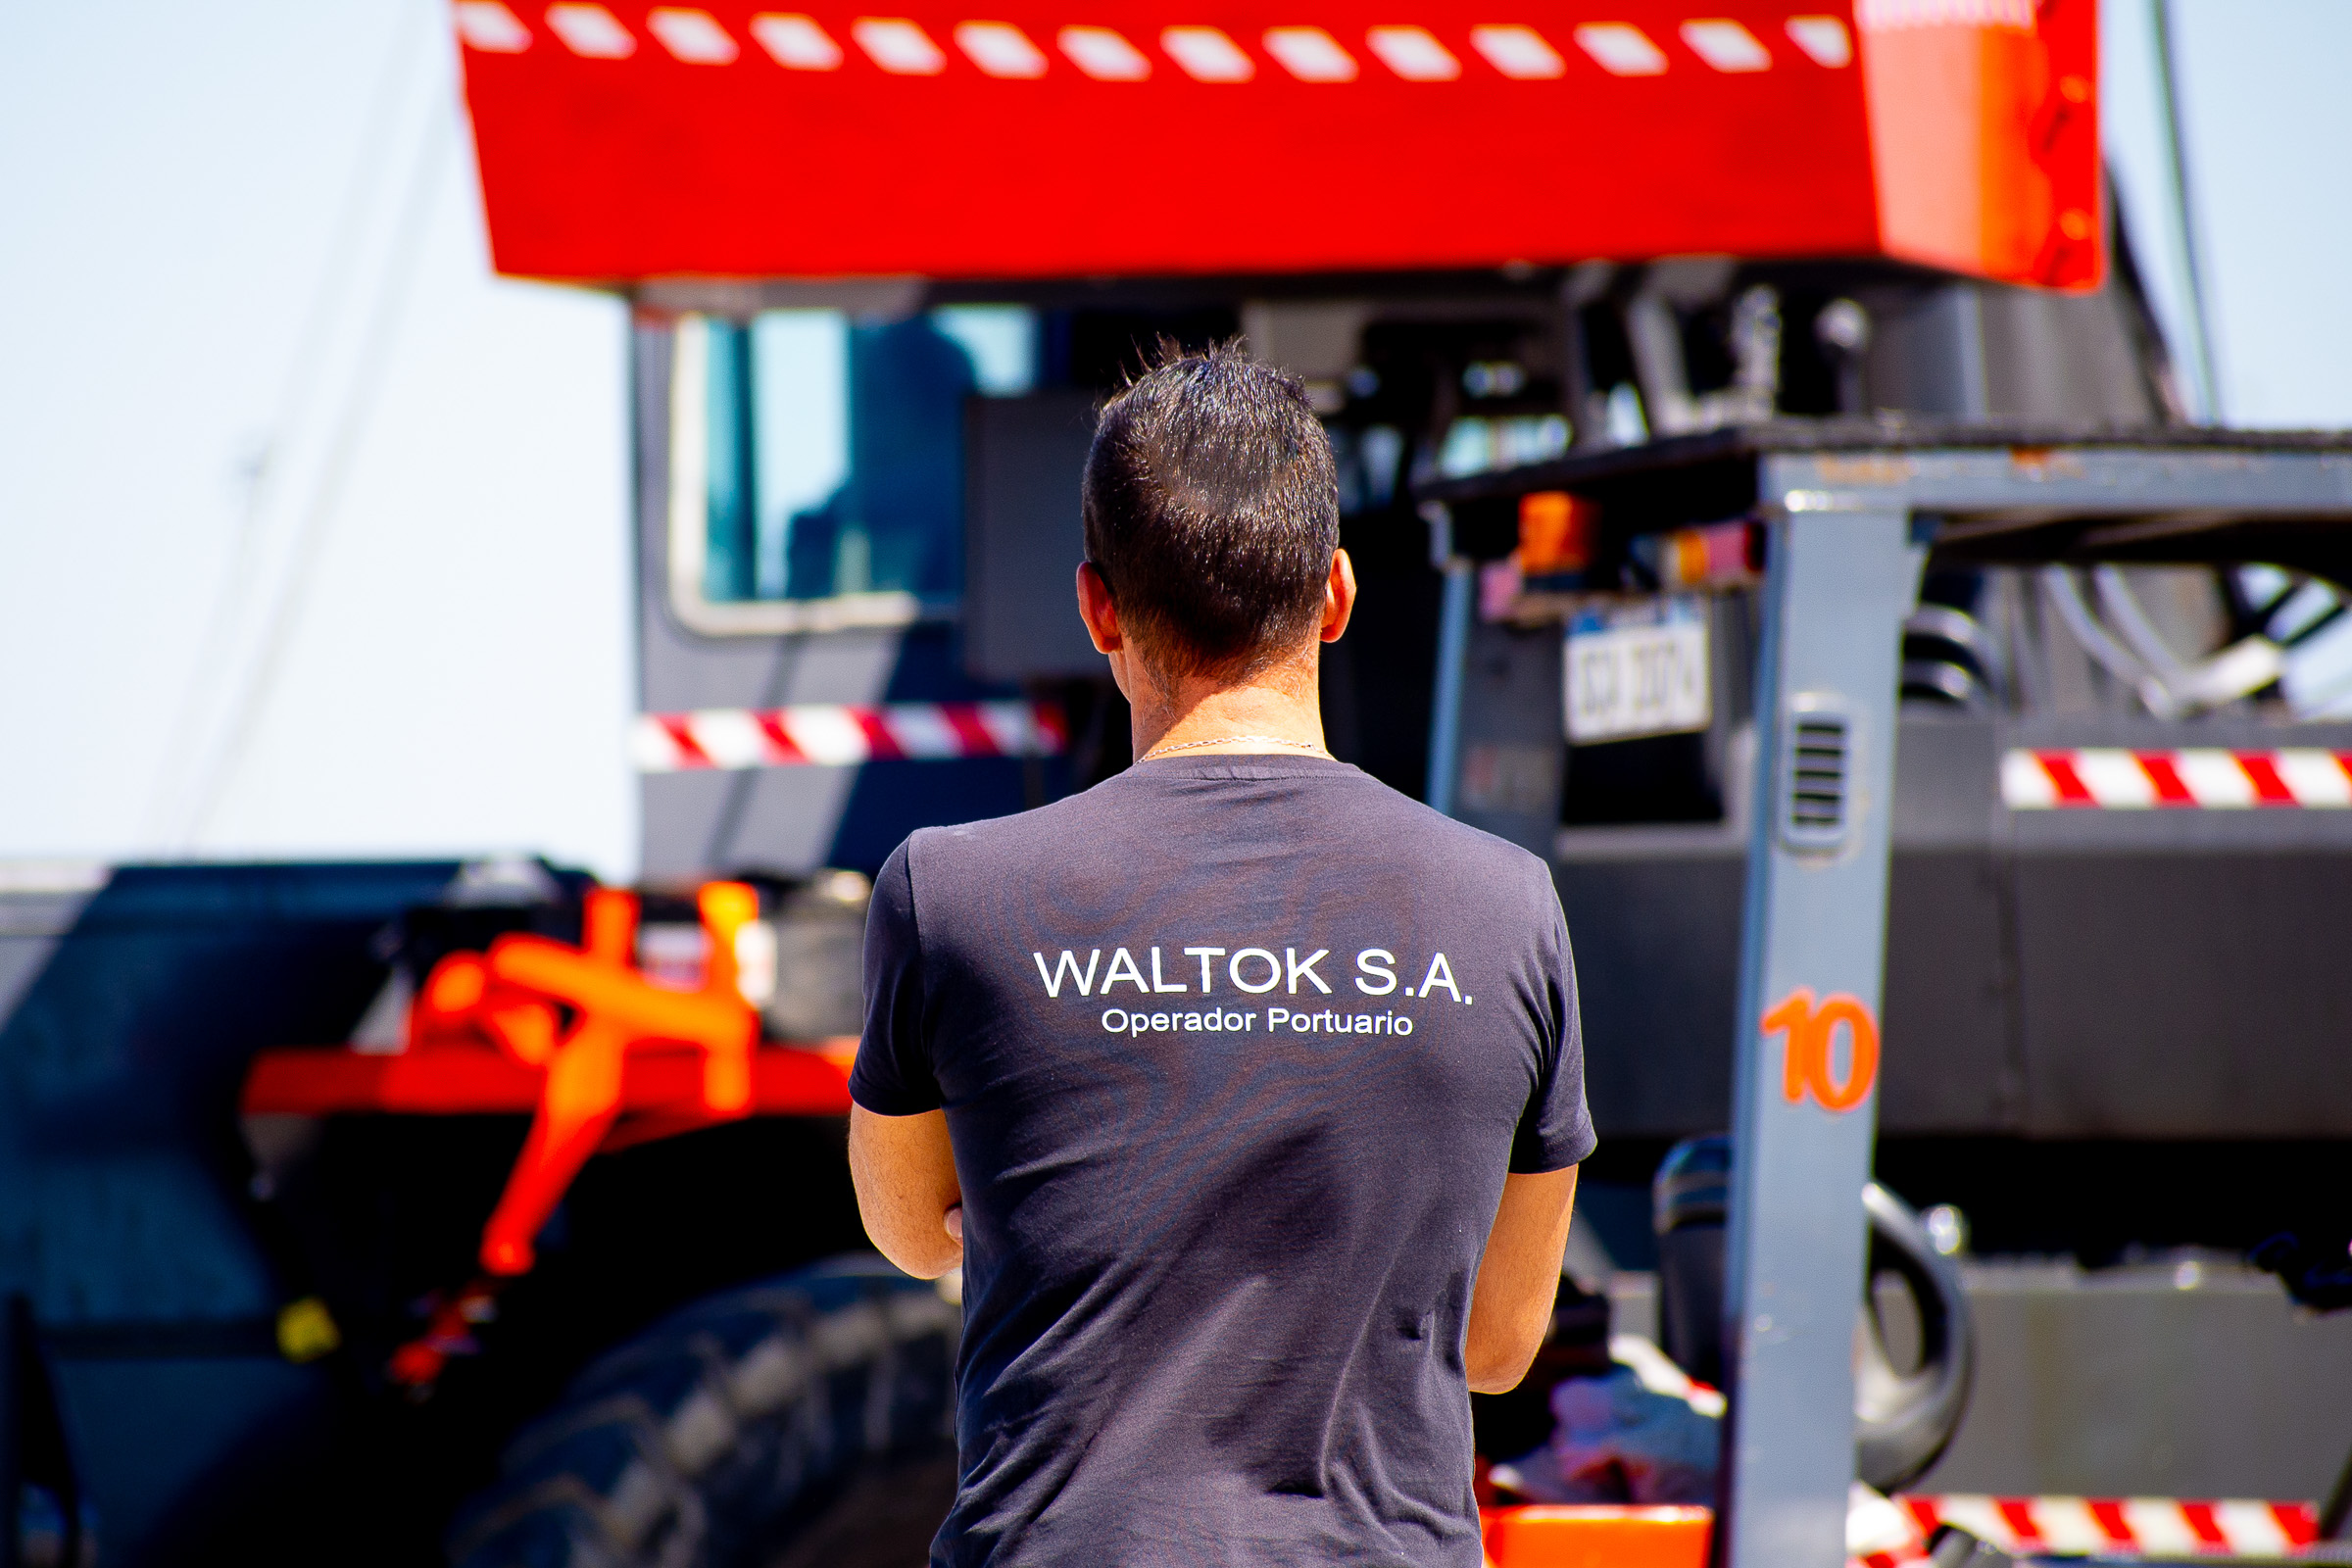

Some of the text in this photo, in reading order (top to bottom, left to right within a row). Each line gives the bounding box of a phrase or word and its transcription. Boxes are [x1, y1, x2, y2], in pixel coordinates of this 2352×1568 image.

[1032, 946, 1473, 1005] WALTOK S.A.
[1101, 1006, 1413, 1039] Operador Portuario
[1760, 988, 1879, 1113] 10
